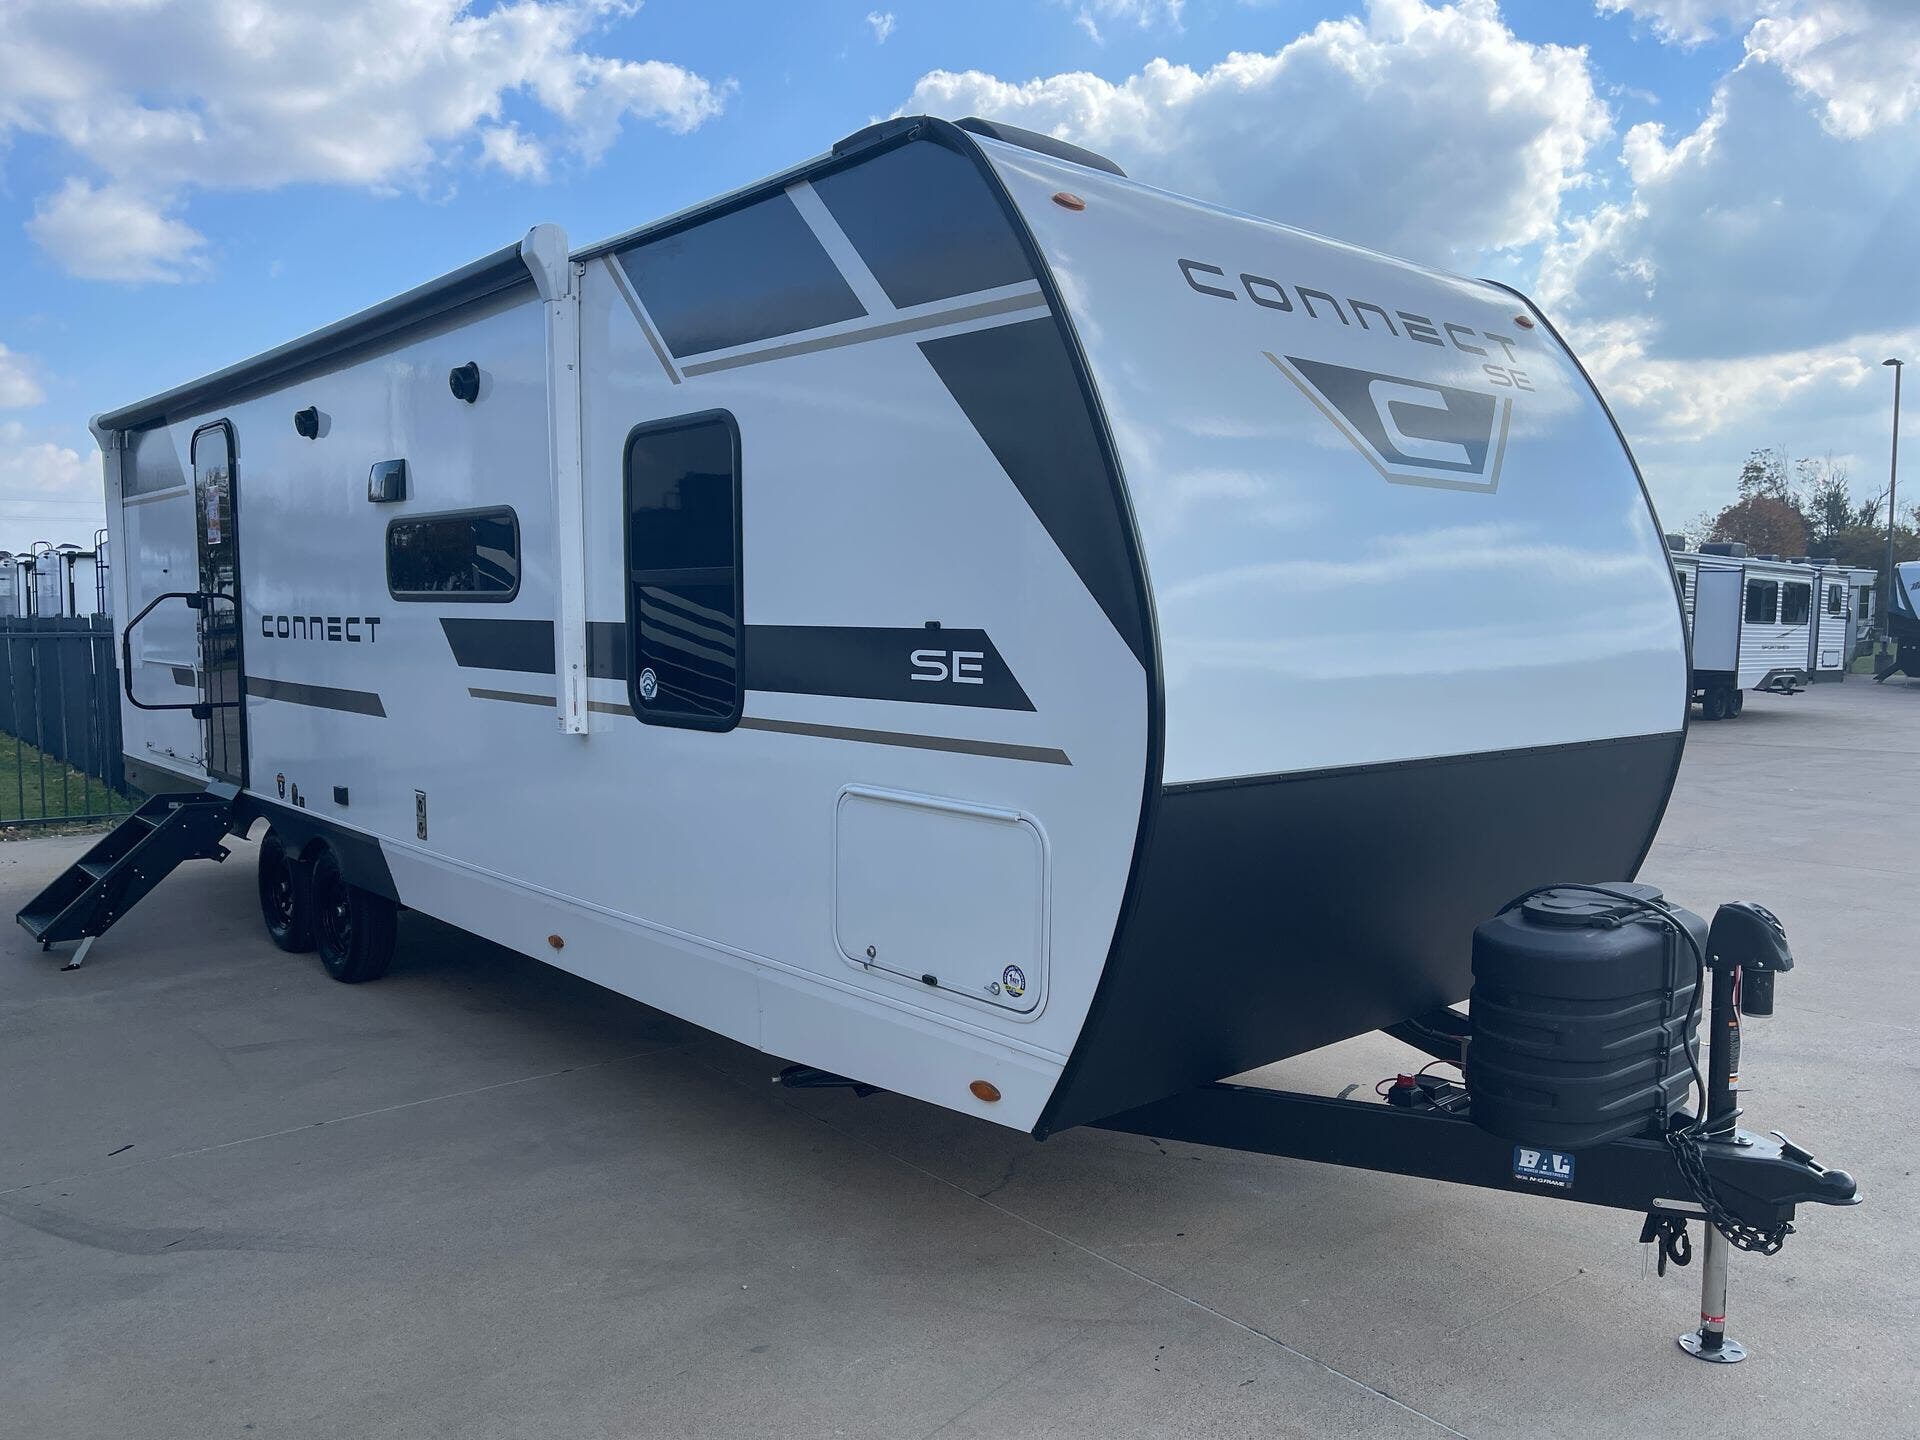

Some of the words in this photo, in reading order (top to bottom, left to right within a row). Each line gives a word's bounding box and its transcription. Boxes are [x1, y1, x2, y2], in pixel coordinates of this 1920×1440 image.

[1177, 258, 1517, 364] CONNECT
[1482, 363, 1536, 393] SE
[261, 615, 381, 643] CONNECT
[910, 649, 984, 685] SE
[1519, 1149, 1570, 1174] BAL
